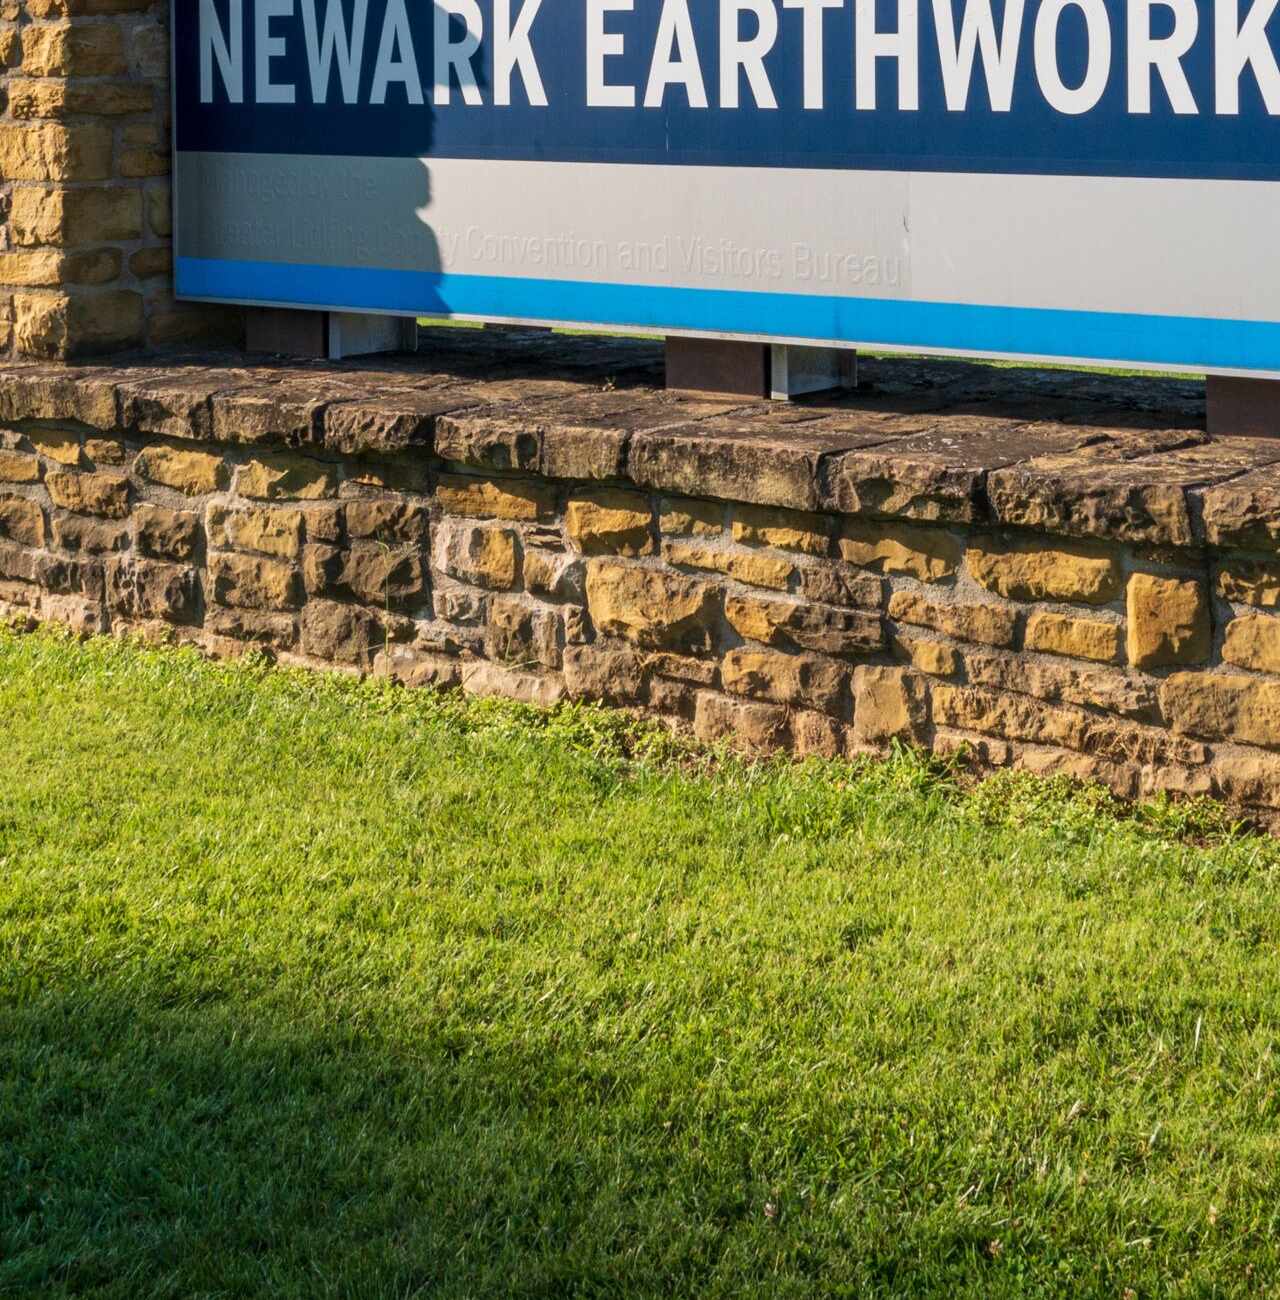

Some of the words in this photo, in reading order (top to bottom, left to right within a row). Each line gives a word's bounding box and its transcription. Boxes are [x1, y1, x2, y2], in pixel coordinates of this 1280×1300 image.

[465, 226, 609, 269] Convention
[617, 235, 670, 273] and
[677, 236, 784, 280] Visitors
[791, 242, 903, 287] Bureau
